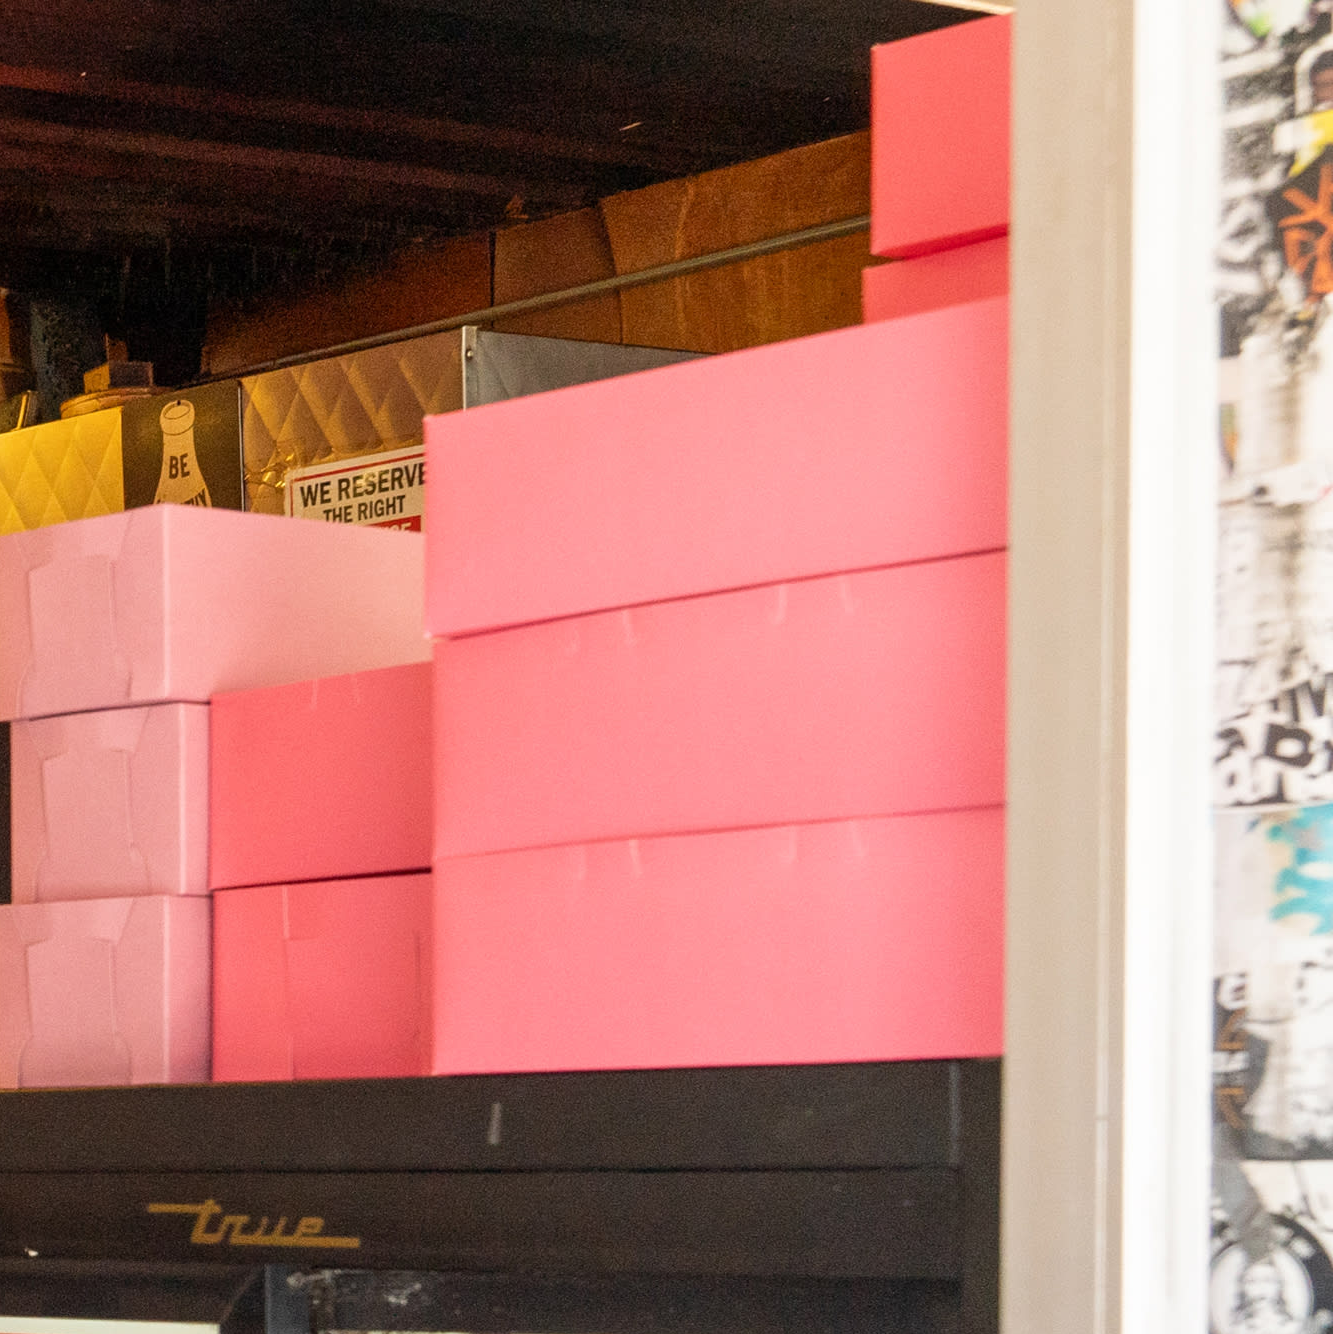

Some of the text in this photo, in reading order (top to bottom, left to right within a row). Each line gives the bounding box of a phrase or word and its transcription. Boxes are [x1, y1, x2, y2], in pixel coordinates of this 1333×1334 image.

[169, 453, 190, 479] BE
[300, 481, 331, 508] WE
[323, 495, 406, 523] THE RIGHT
[148, 1199, 360, 1248] true
